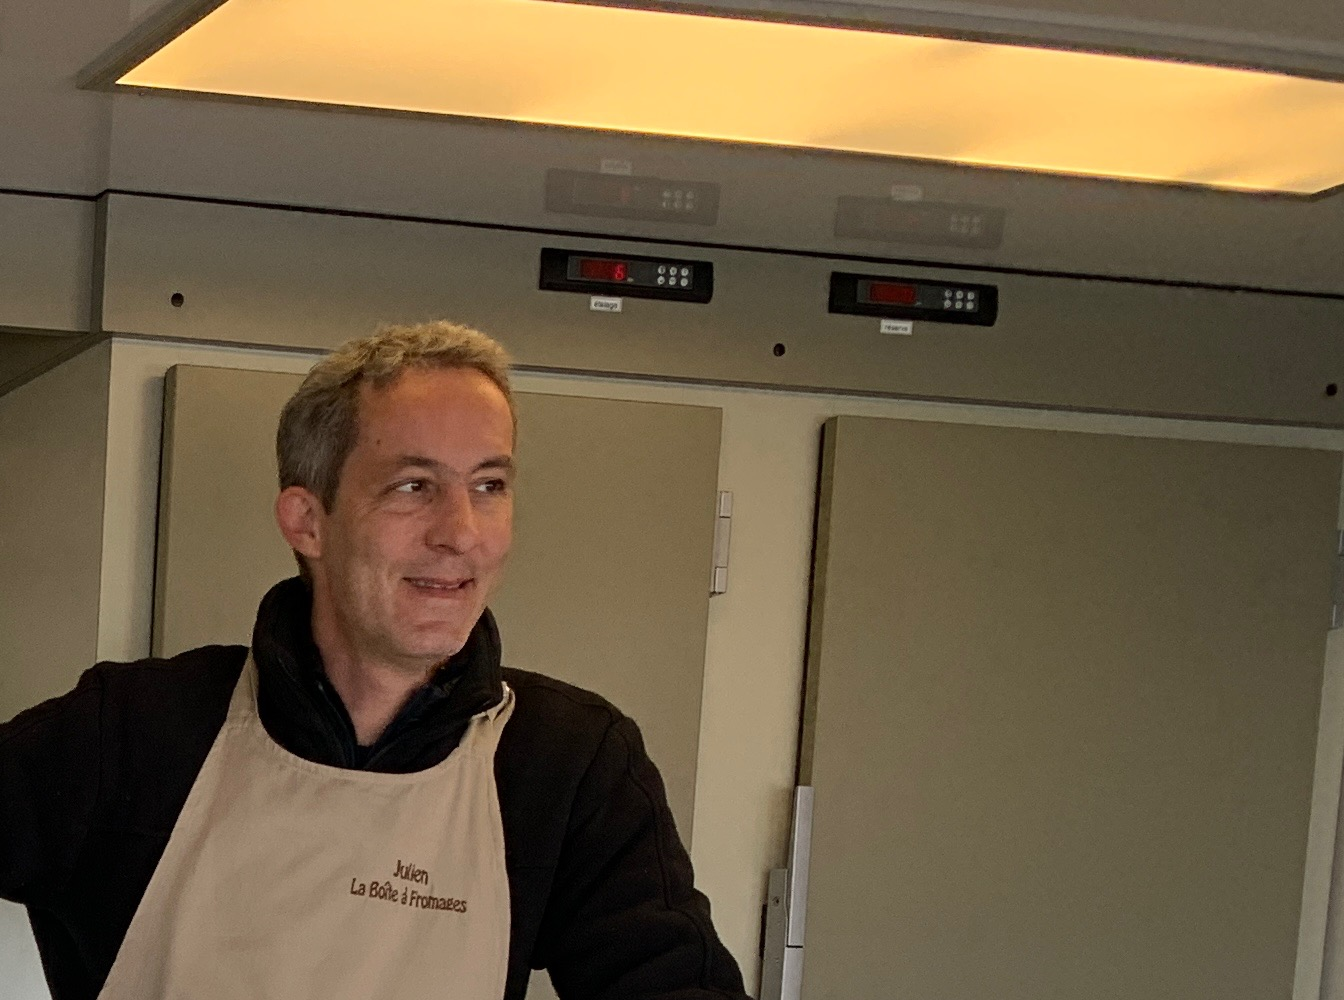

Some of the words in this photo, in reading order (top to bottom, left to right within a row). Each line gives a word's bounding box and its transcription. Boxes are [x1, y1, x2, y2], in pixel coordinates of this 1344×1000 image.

[393, 859, 428, 885] Julien
[350, 878, 366, 895] La
[369, 881, 398, 903] Boîte
[401, 887, 407, 905] à
[409, 889, 468, 913] Fromages
